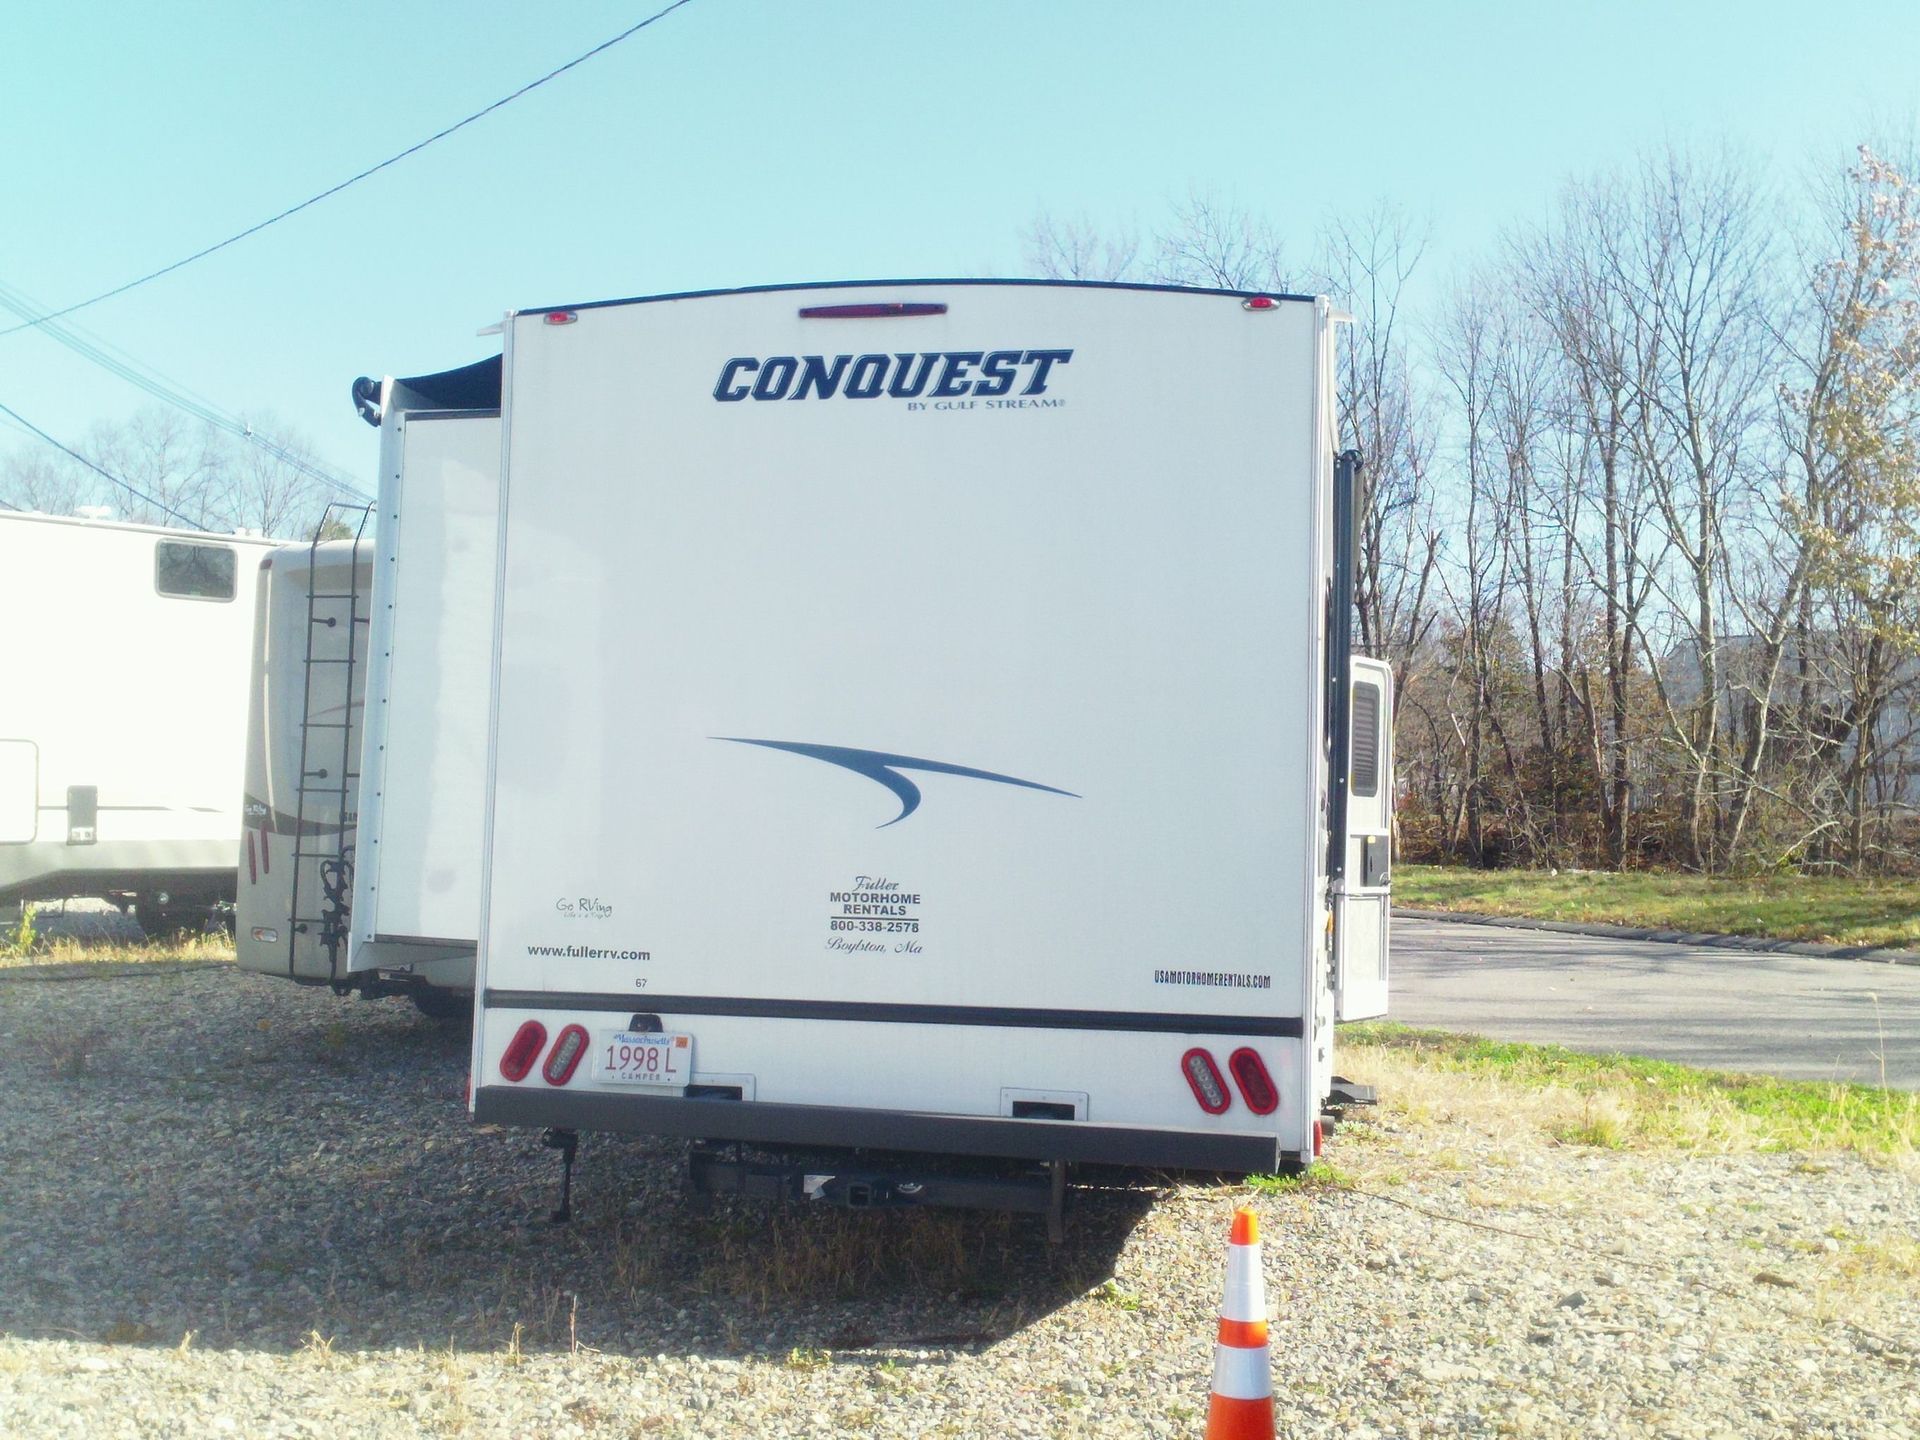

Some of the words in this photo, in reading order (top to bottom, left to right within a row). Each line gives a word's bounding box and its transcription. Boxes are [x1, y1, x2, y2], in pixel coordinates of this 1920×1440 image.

[712, 349, 1075, 402] CONQUEST
[907, 402, 927, 411] BY
[934, 401, 979, 410] GULF
[852, 876, 900, 892] Fuller
[830, 892, 921, 905] MOTORHOME
[556, 897, 574, 911] Go
[578, 897, 613, 919] RVing
[843, 904, 907, 916] RENTALS
[830, 920, 920, 933] 800-338-2578
[527, 945, 651, 961] www.fullerrv.com
[894, 939, 923, 954] Ma
[635, 978, 647, 988] 67
[1154, 969, 1271, 989] USAMOTORHOMERENTALS.COM
[621, 1072, 660, 1081] CAMPER
